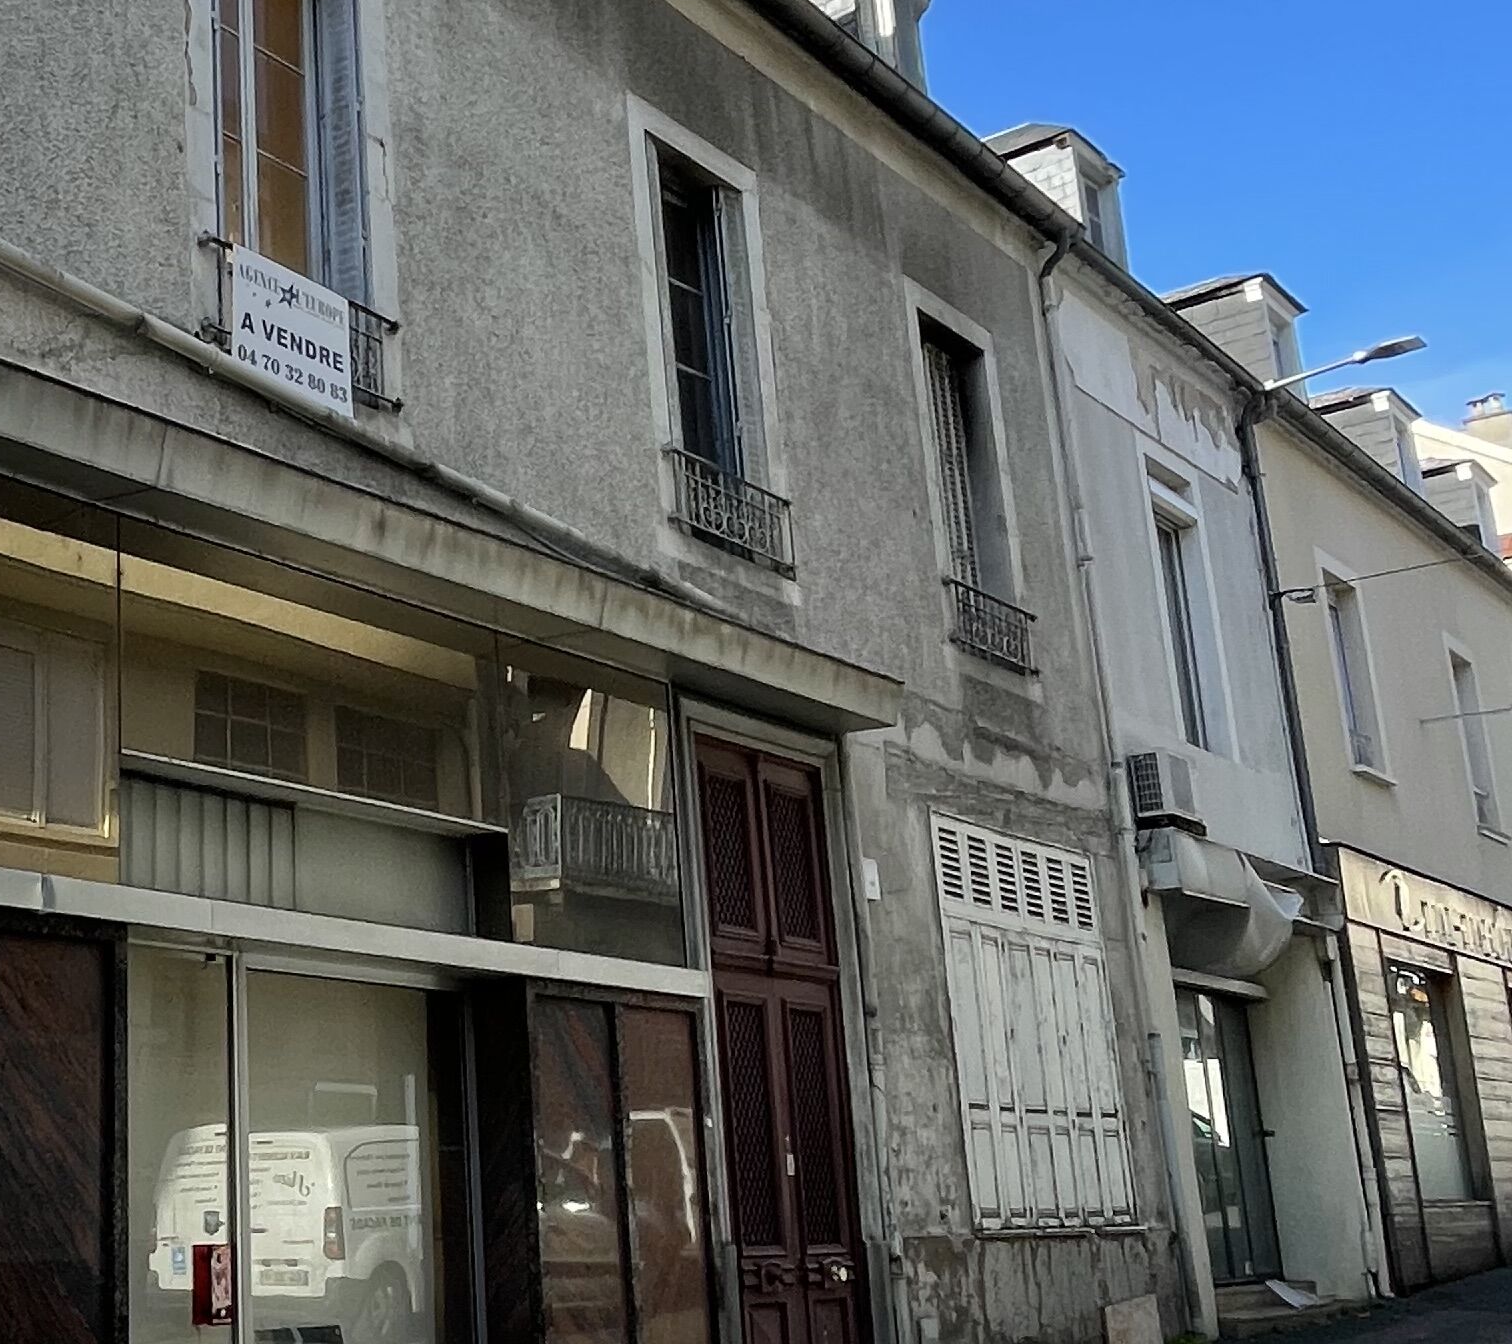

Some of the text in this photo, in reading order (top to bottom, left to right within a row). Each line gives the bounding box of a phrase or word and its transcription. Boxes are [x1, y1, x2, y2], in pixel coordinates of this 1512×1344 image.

[240, 312, 344, 373] A VENDRE
[238, 344, 348, 403] 04 70 32 80 83
